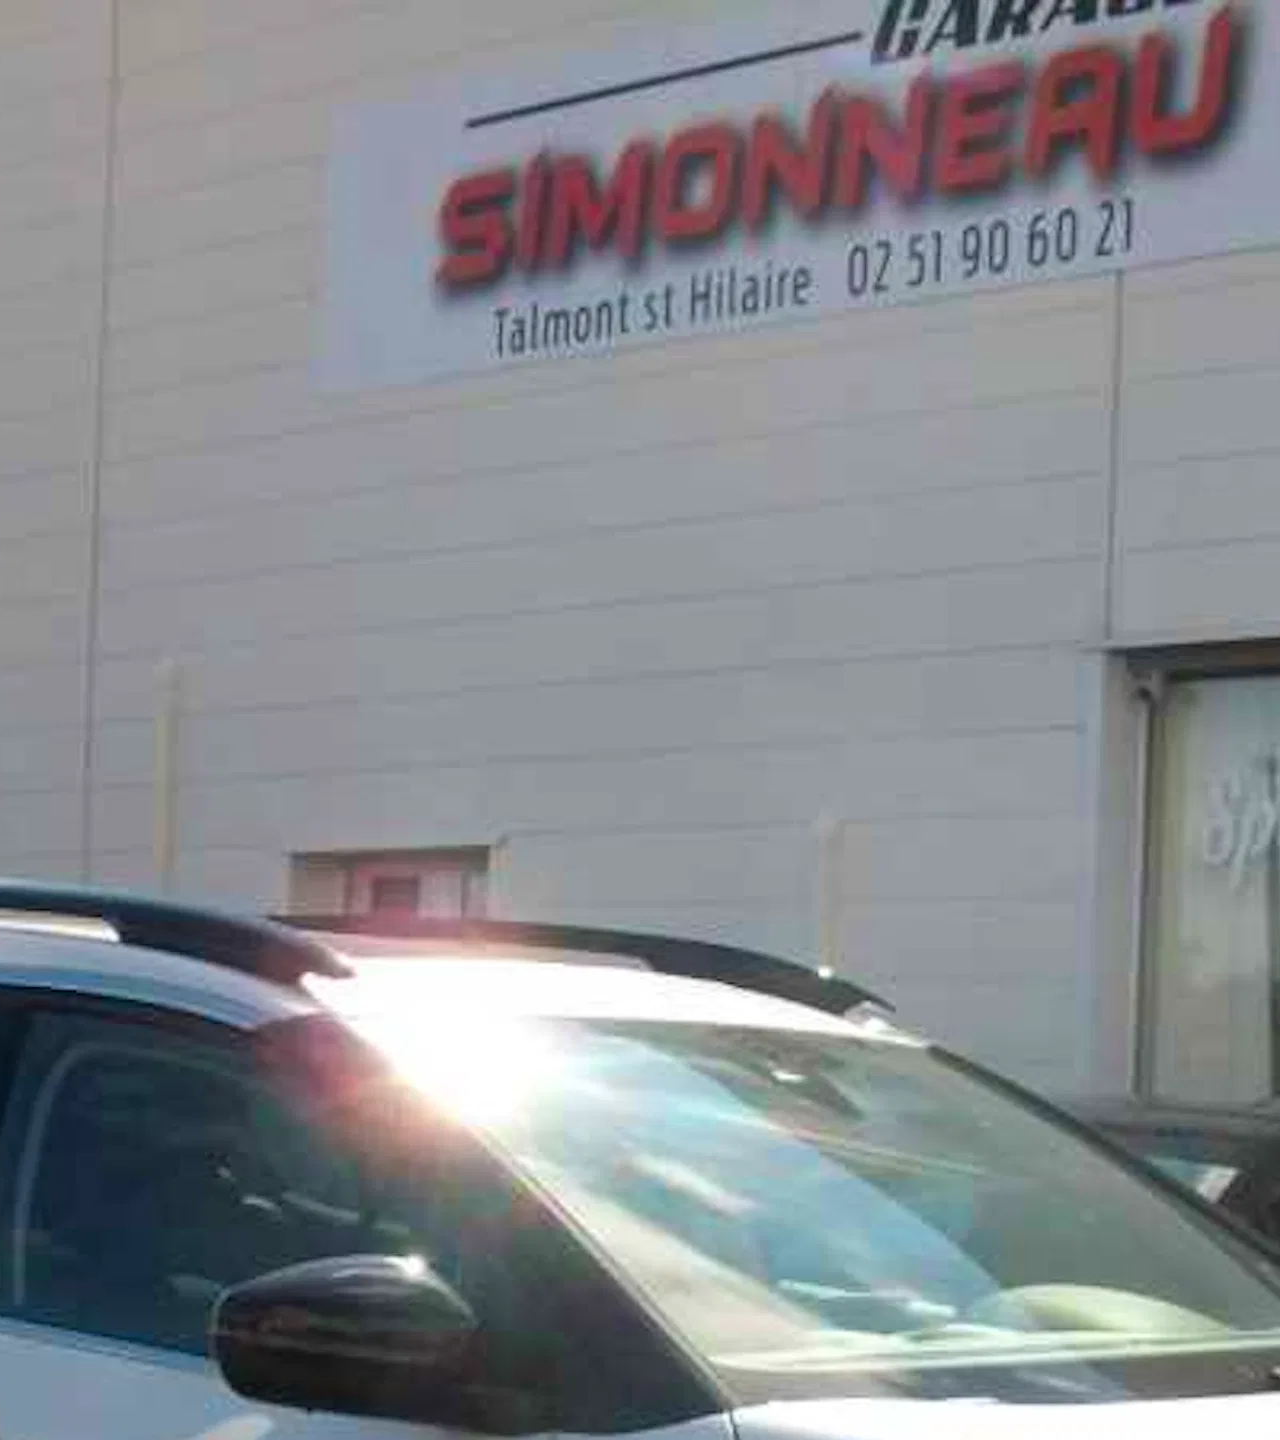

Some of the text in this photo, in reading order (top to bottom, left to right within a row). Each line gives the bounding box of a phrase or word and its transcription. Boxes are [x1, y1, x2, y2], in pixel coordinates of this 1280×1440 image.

[870, 0, 1196, 64] GAR
[433, 8, 1238, 290] SIMONNEAU
[493, 198, 1133, 358] Talmont st Hilaire 02 51 90 60 21
